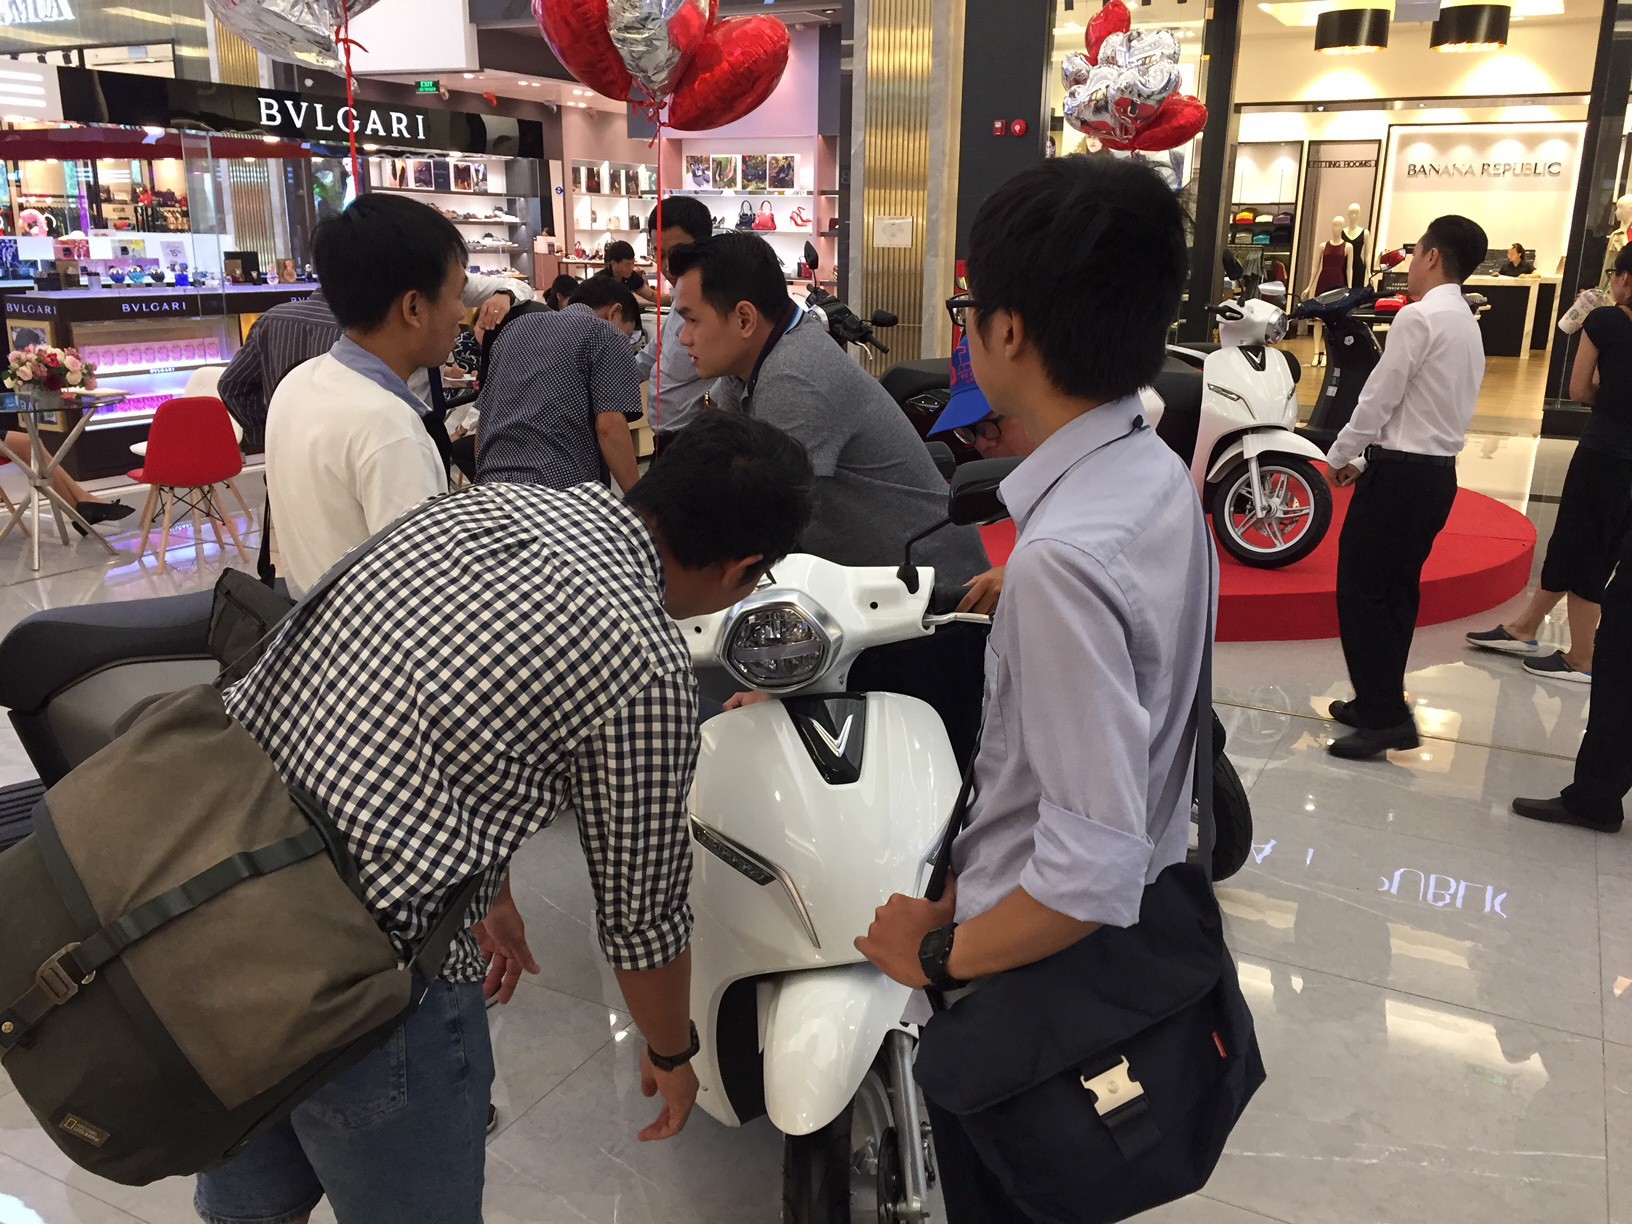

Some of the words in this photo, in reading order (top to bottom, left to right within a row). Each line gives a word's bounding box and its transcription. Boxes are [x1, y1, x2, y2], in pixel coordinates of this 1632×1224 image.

[258, 97, 426, 140] BVLGARI
[1343, 160, 1372, 168] ROOMS
[1407, 163, 1475, 177] BANANA
[1481, 162, 1562, 177] REPUBLIC
[6, 302, 57, 315] BVLGARI
[121, 301, 187, 313] BVLGARI
